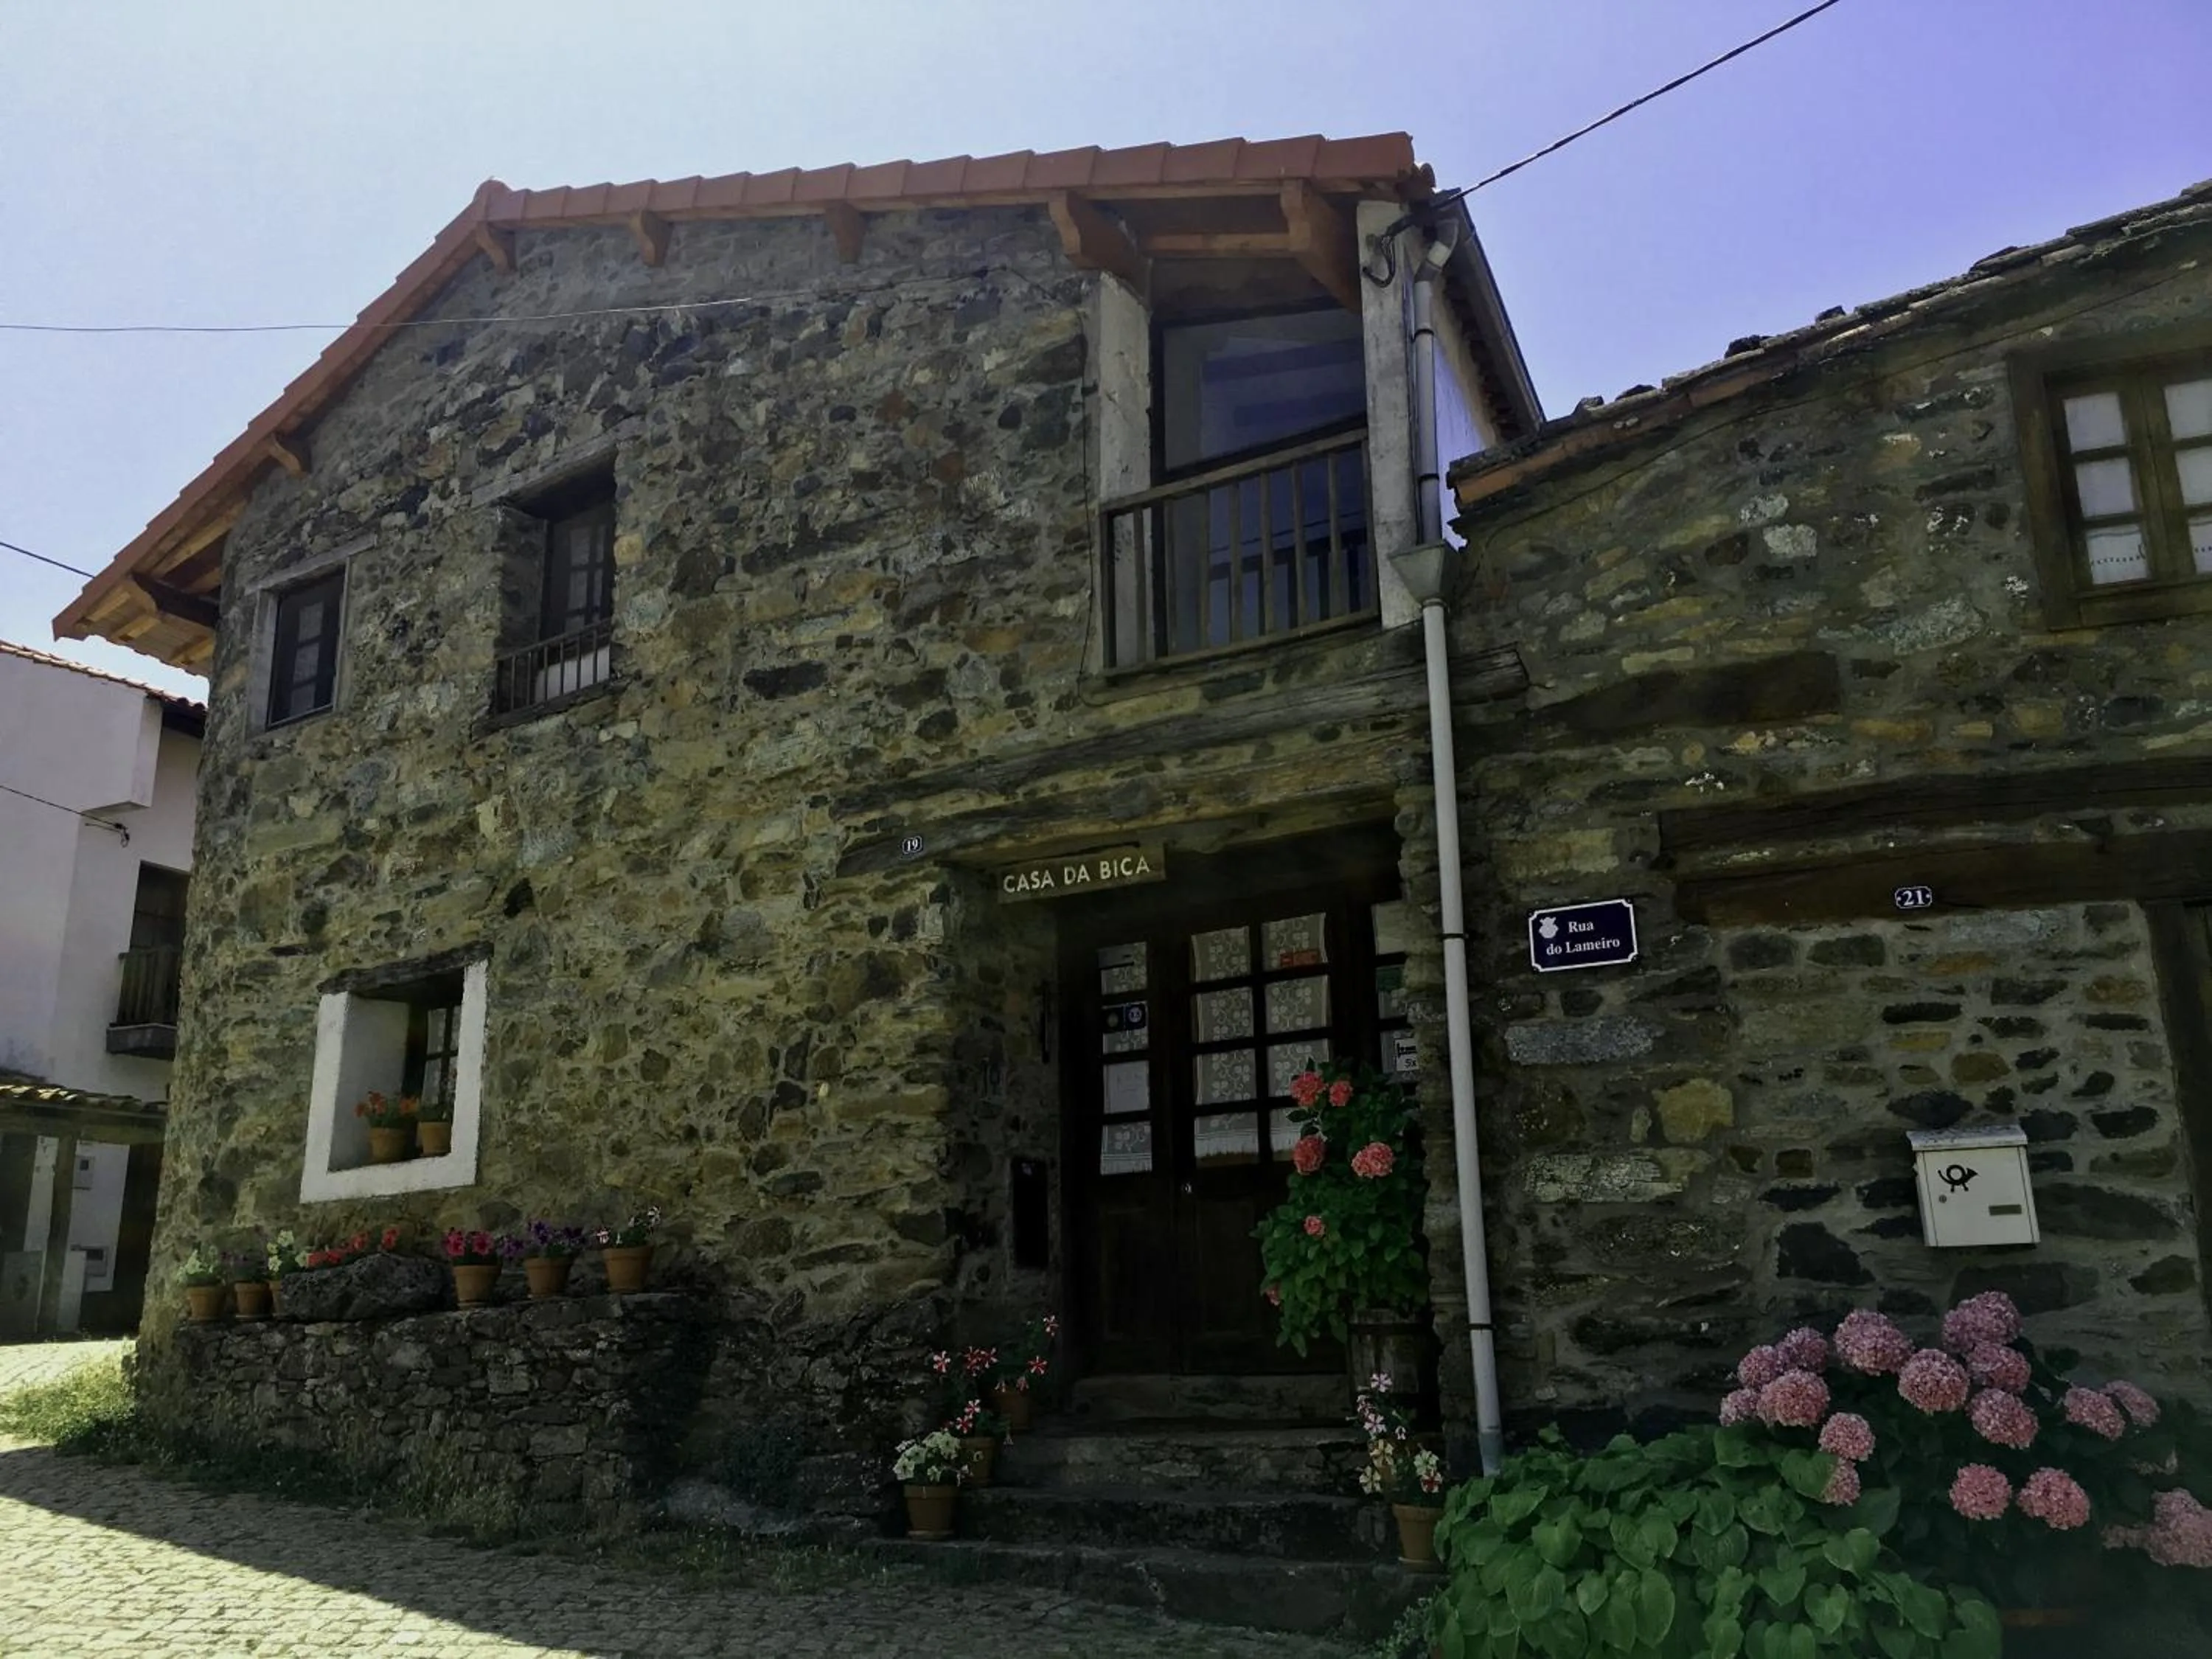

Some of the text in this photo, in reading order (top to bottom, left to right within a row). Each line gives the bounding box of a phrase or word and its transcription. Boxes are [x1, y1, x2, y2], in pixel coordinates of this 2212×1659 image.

[908, 839, 918, 851] 19
[1004, 856, 1150, 893] CASA DA BICA
[1902, 890, 1925, 905] 21
[1568, 921, 1594, 933] Rua
[1546, 937, 1621, 956] do Lameiro
